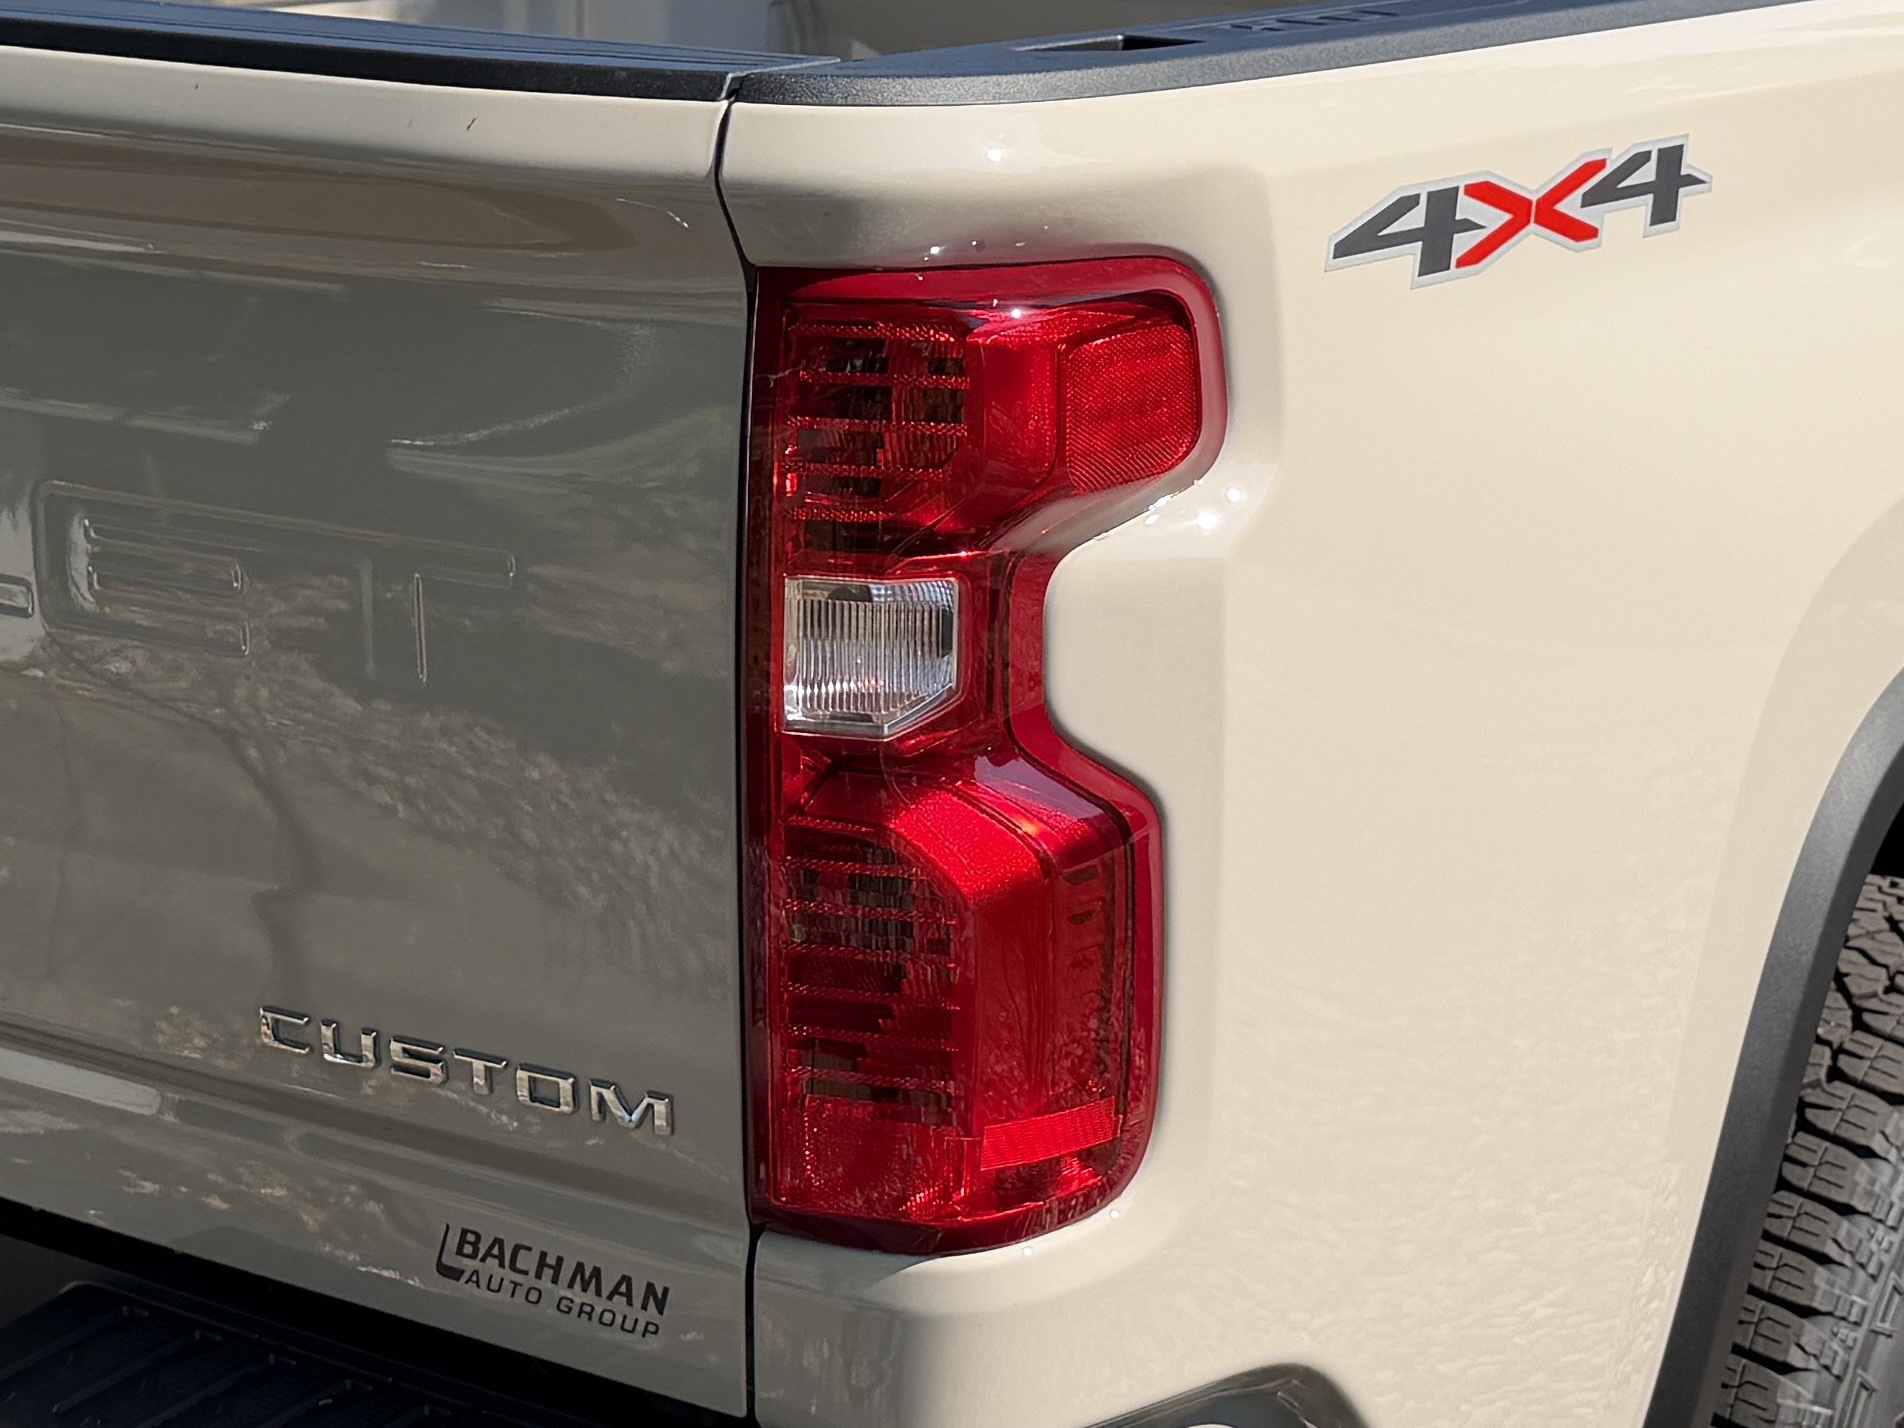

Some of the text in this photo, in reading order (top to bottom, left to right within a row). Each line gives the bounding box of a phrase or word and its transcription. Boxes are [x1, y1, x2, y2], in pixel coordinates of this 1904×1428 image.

[259, 1005, 676, 1137] CUSTOM
[454, 1226, 671, 1317] BACHMAN
[464, 1267, 661, 1339] AUTO GROUP
